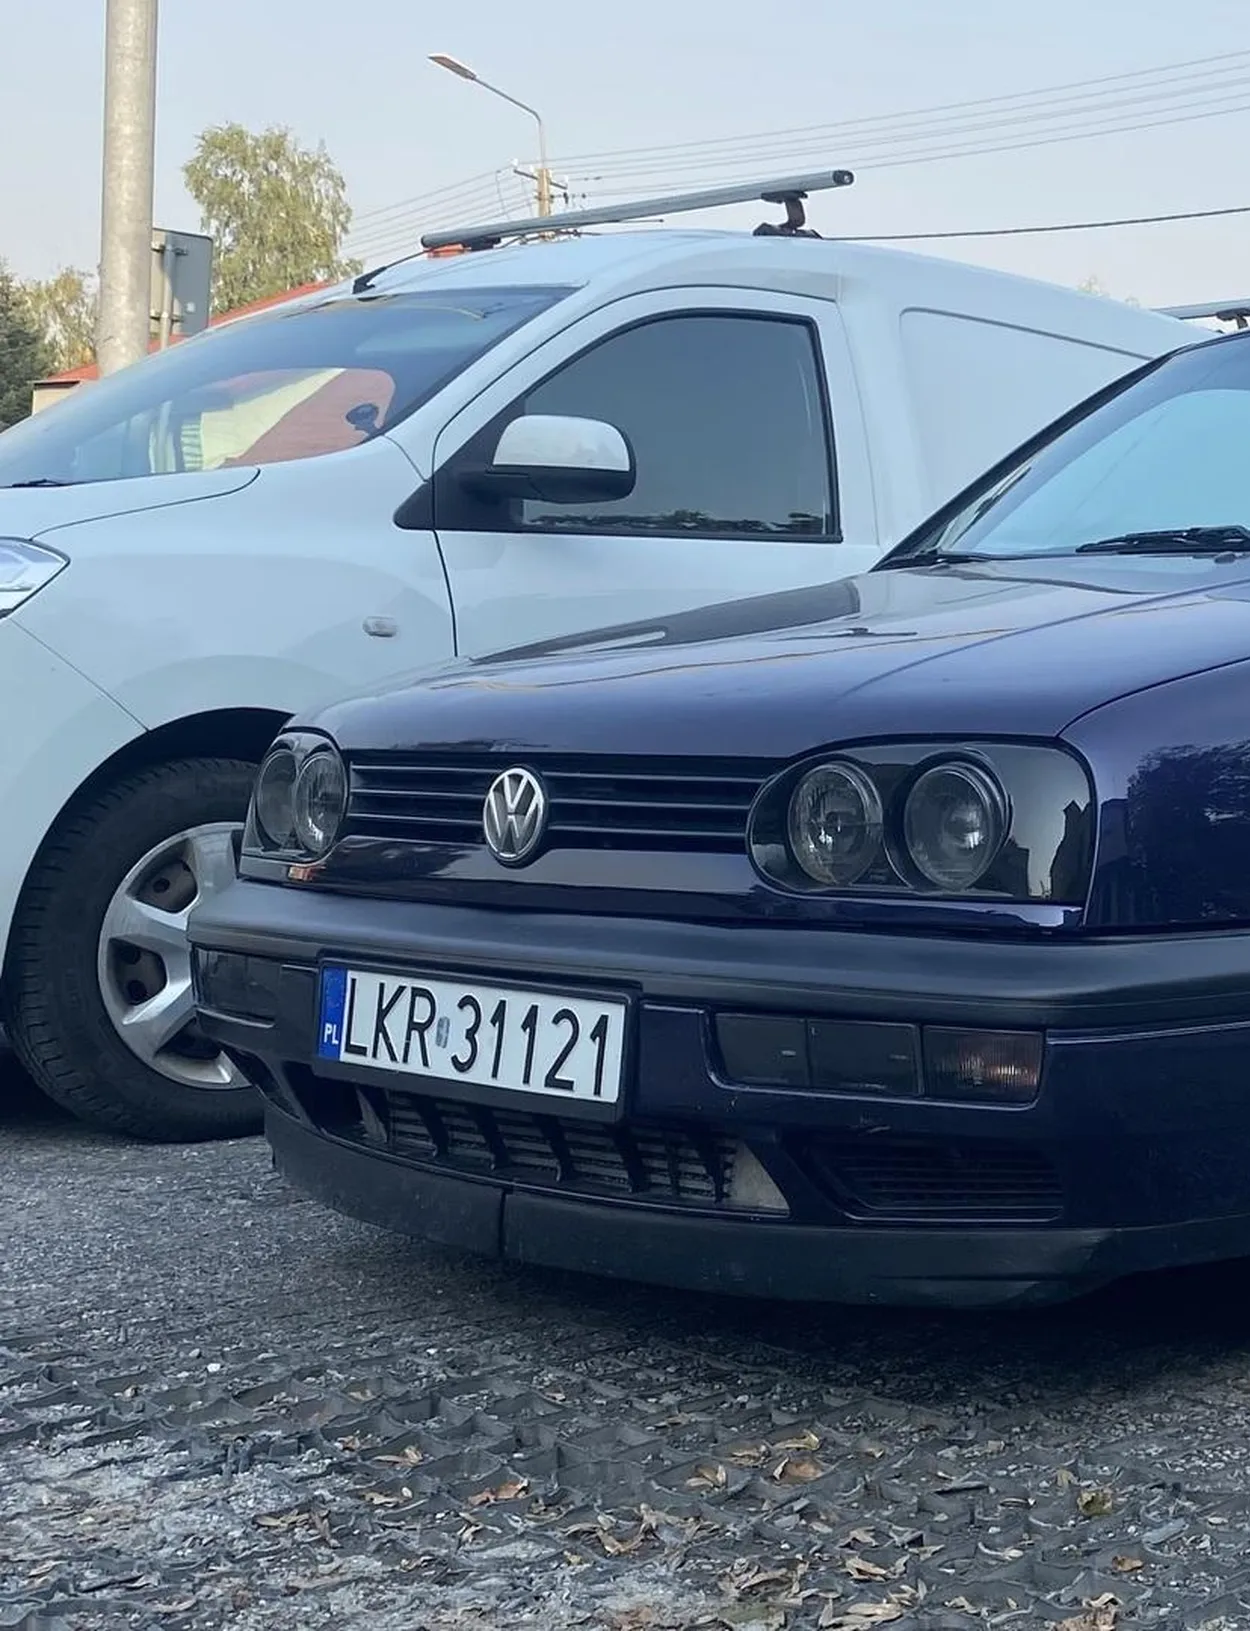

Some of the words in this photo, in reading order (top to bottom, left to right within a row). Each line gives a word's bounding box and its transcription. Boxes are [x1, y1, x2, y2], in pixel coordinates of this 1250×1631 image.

[485, 770, 543, 858] VW
[323, 1022, 339, 1045] PL
[344, 977, 437, 1068] LKR
[450, 993, 610, 1097] 31121
